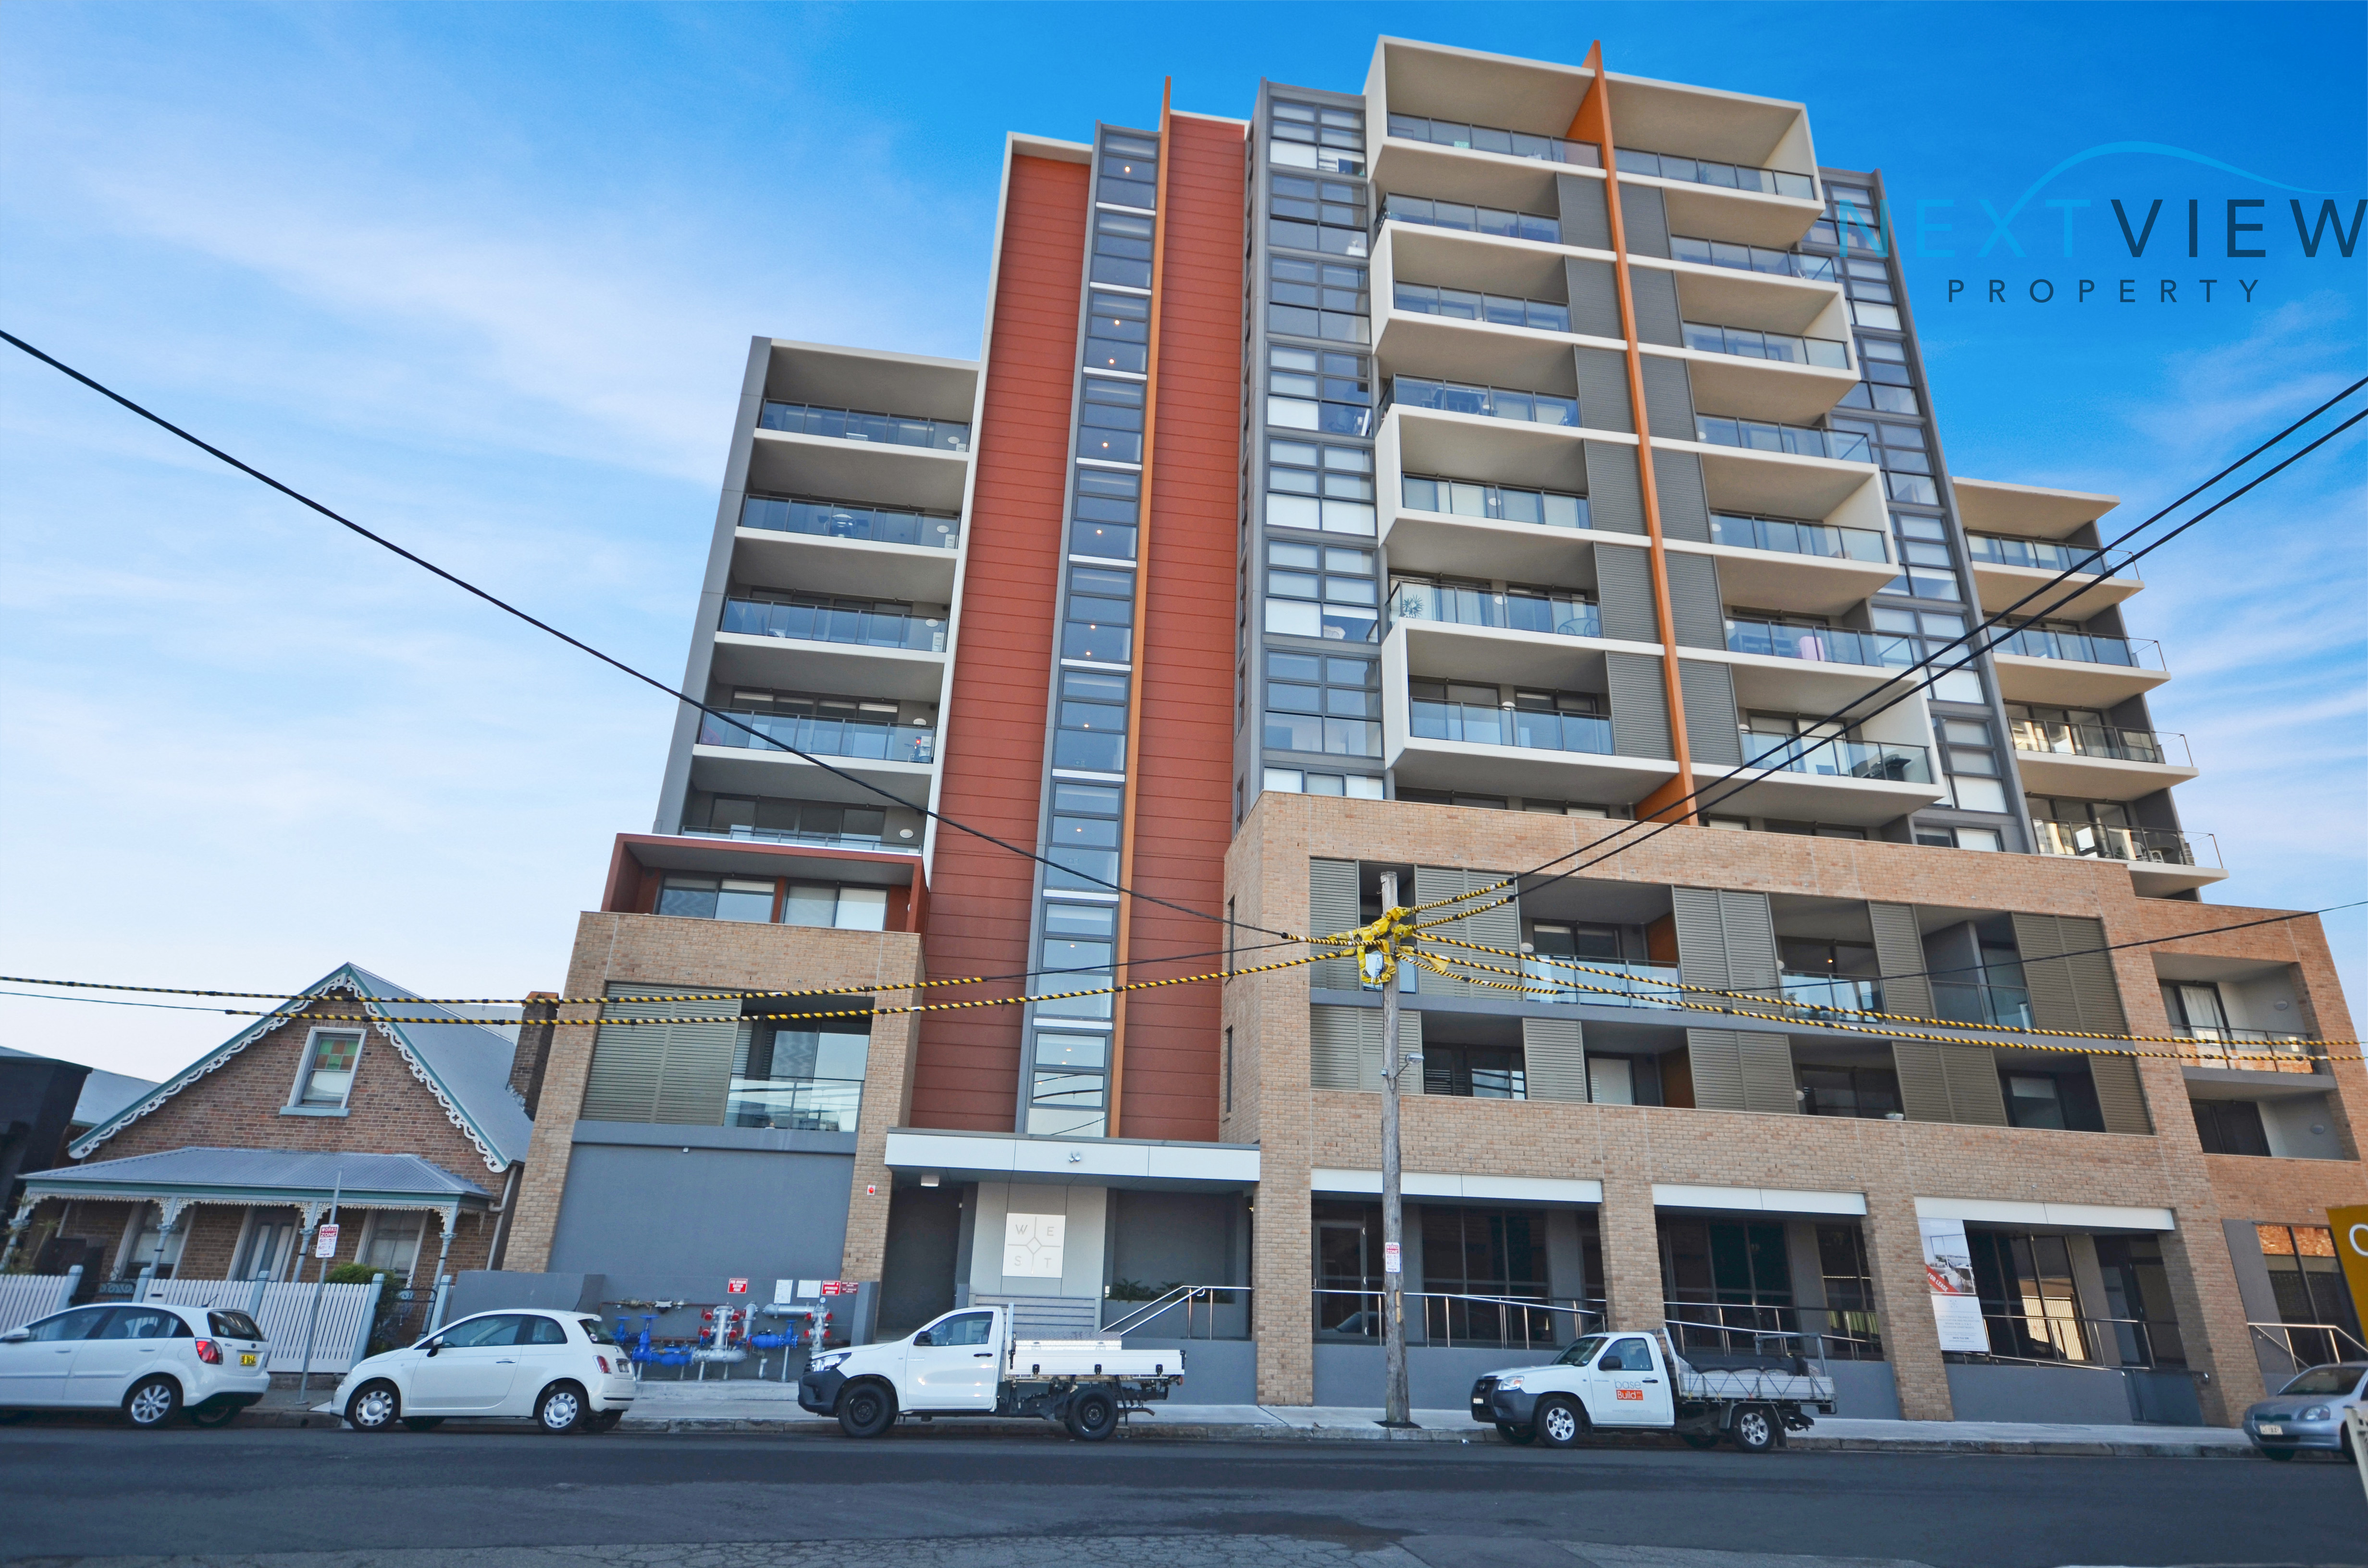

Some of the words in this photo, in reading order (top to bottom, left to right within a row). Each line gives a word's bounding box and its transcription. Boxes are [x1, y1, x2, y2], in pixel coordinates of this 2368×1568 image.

[1927, 1273, 1936, 1282] FOR
[1936, 1279, 1949, 1292] LEASE
[1615, 1379, 1641, 1389] base
[1617, 1390, 1636, 1399] Build
